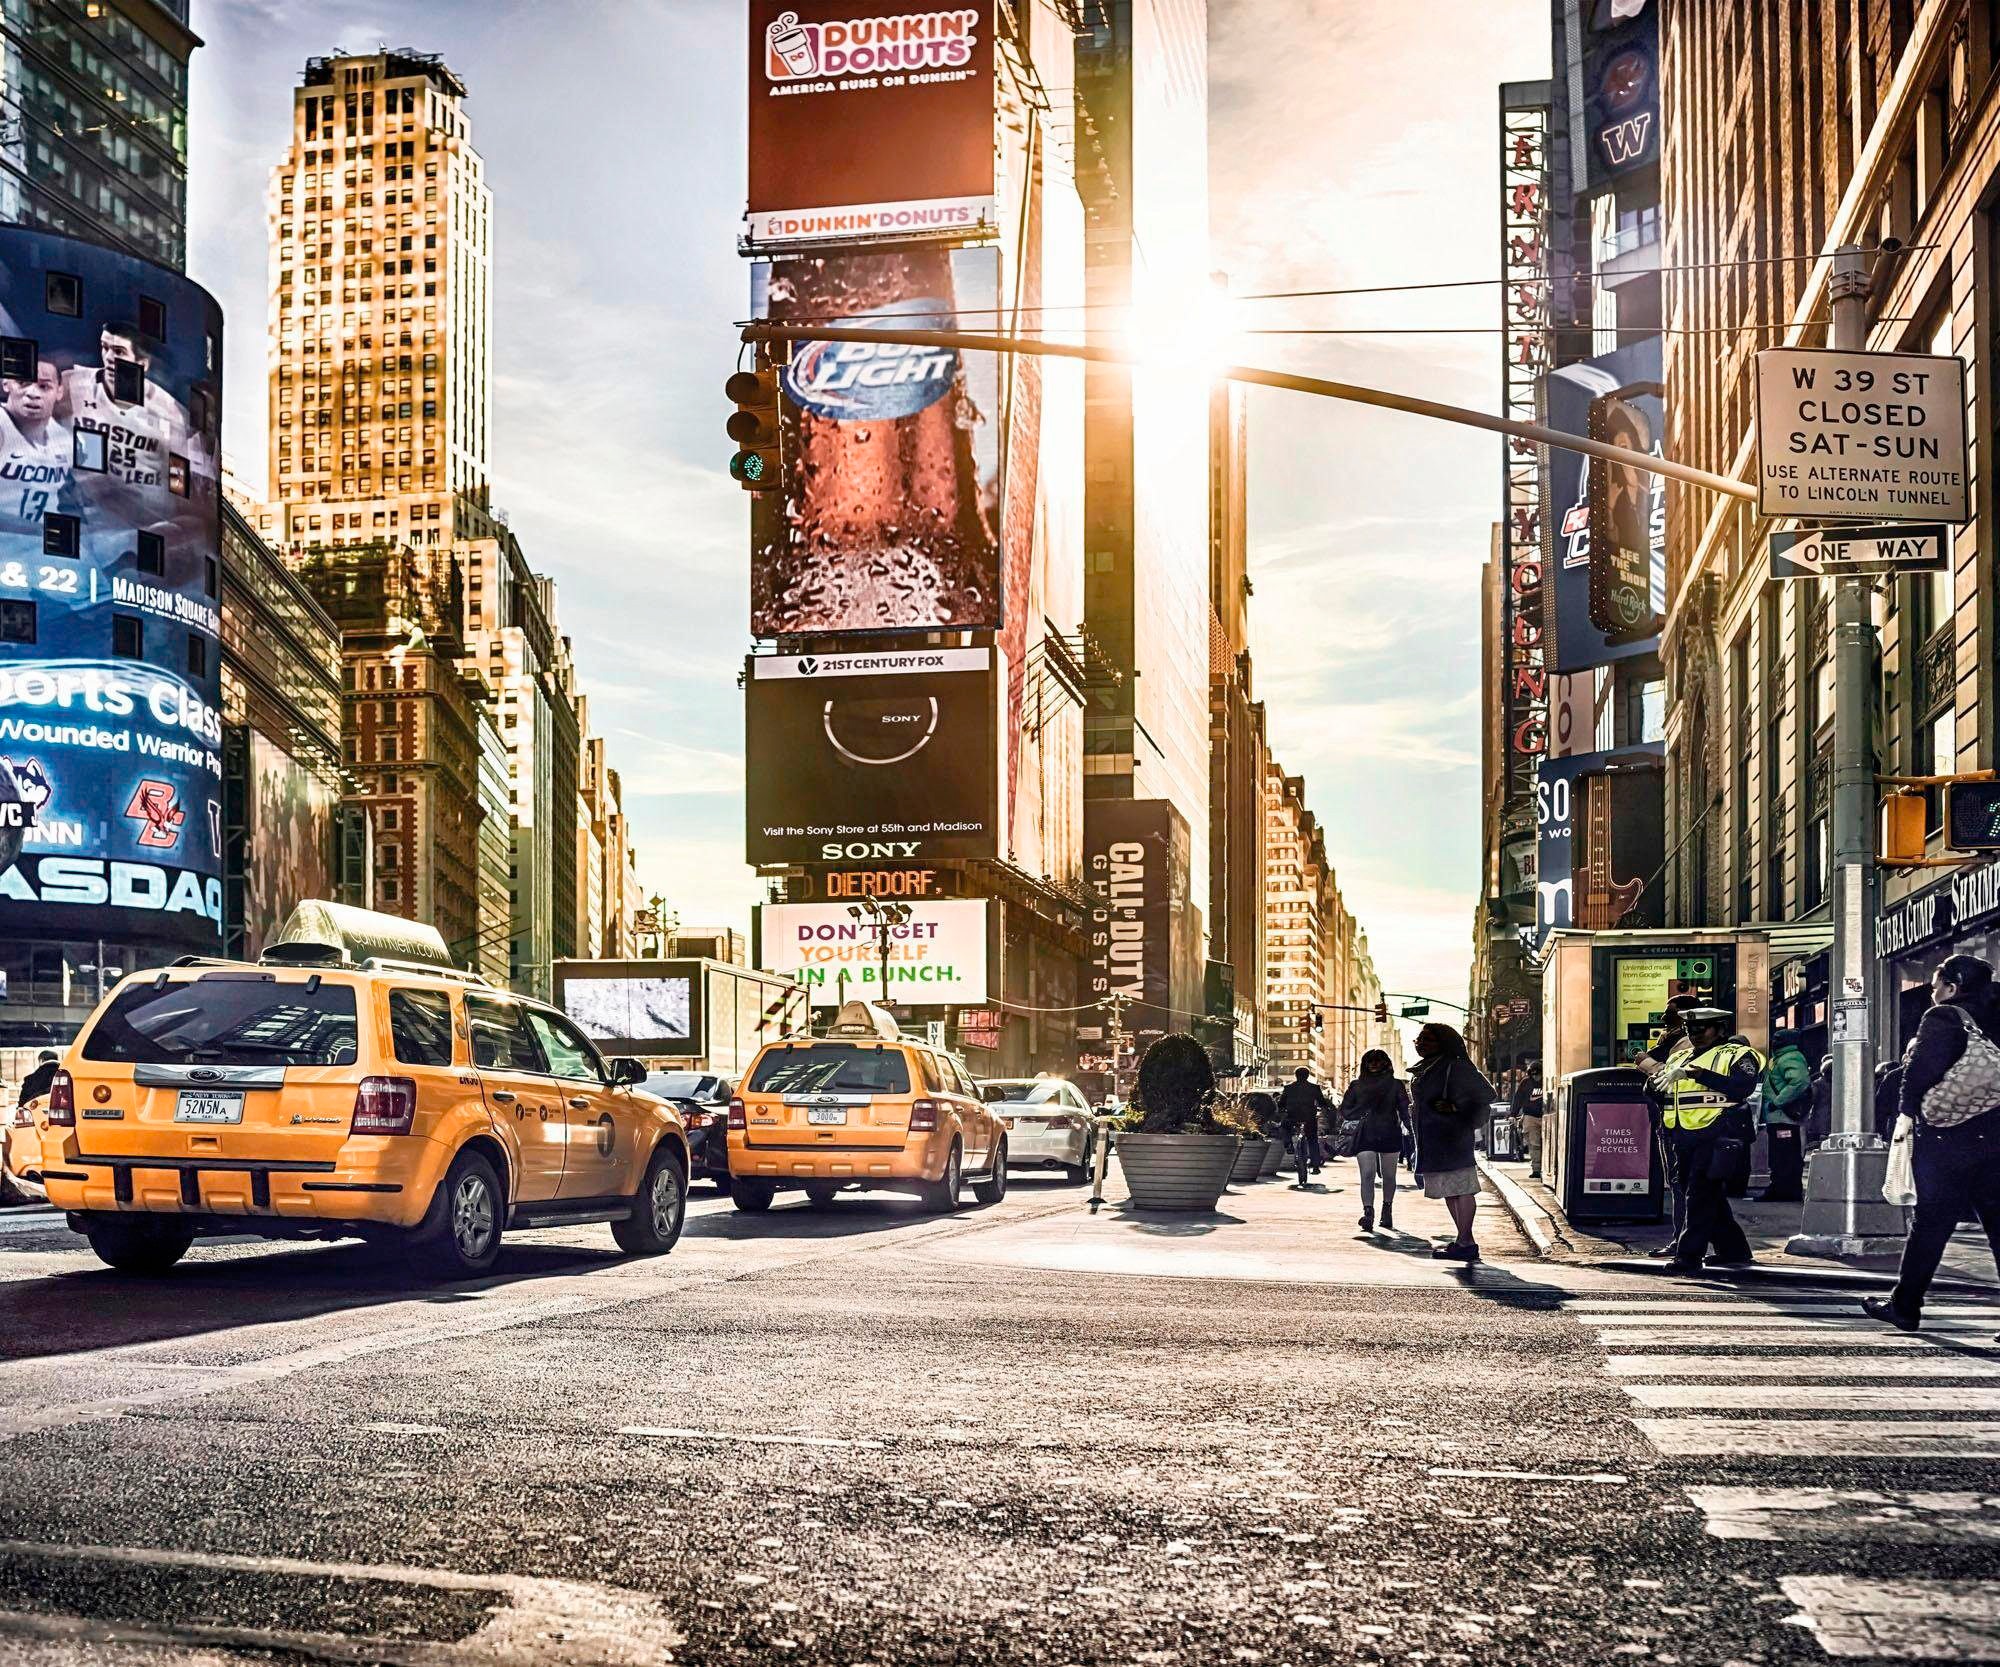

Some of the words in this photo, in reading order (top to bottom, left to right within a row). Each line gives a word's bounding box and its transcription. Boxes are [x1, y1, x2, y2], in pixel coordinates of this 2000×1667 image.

[824, 13, 974, 47] DUNKIN'
[825, 38, 966, 73] DONUTS
[769, 82, 835, 96] AMERICA
[839, 78, 878, 90] RUNS
[882, 75, 905, 87] ON
[810, 353, 953, 390] LIGHT
[1792, 367, 1816, 389] W
[1834, 369, 1875, 392] 39
[1892, 373, 1929, 395] ST
[1799, 400, 1926, 427] CLOSED
[1767, 465, 1798, 478] USE
[1808, 466, 1901, 483] ALTERNATE
[1909, 471, 1960, 486] ROUTE
[1779, 485, 1799, 499] TO
[1808, 487, 1879, 502] LINCOLN
[1888, 489, 1950, 505] TUNNEL
[1619, 547, 1640, 564] SEE
[1804, 543, 1851, 562] ONE
[1877, 539, 1928, 559] WAY
[1610, 554, 1631, 571] THE
[0, 562, 28, 588] &
[39, 566, 77, 594] 22
[1620, 570, 1647, 588] SHOW
[823, 660, 853, 670] 21ST
[853, 657, 915, 669] CENTURY
[918, 656, 944, 667] FOX
[882, 715, 921, 723] SONY
[0, 718, 130, 751] Wounded
[136, 732, 204, 767] Warrior
[763, 826, 784, 837] Visit
[786, 826, 803, 836] the
[806, 826, 833, 837] Sony
[836, 825, 864, 835] Store
[867, 825, 879, 834] at
[881, 823, 904, 833] 55th
[907, 823, 930, 833] and
[933, 821, 983, 831] Madison
[822, 841, 922, 860] SONY
[1109, 842, 1144, 912] CALL
[1124, 908, 1136, 921] OF
[1875, 912, 1905, 960] BUBBA
[1905, 894, 1936, 946] GUMP
[1950, 861, 2000, 928] SHRIMP
[798, 923, 880, 941] DON'T
[891, 922, 938, 939] GET
[799, 944, 928, 962] YOURSELF
[1109, 920, 1144, 1000] DUTY
[797, 967, 825, 984] IN
[835, 967, 853, 983] A
[862, 965, 962, 983] BUNCH.
[1639, 971, 1662, 979] Google
[1600, 1137, 1635, 1145] SQUARE
[1604, 1128, 1632, 1136] TIMES
